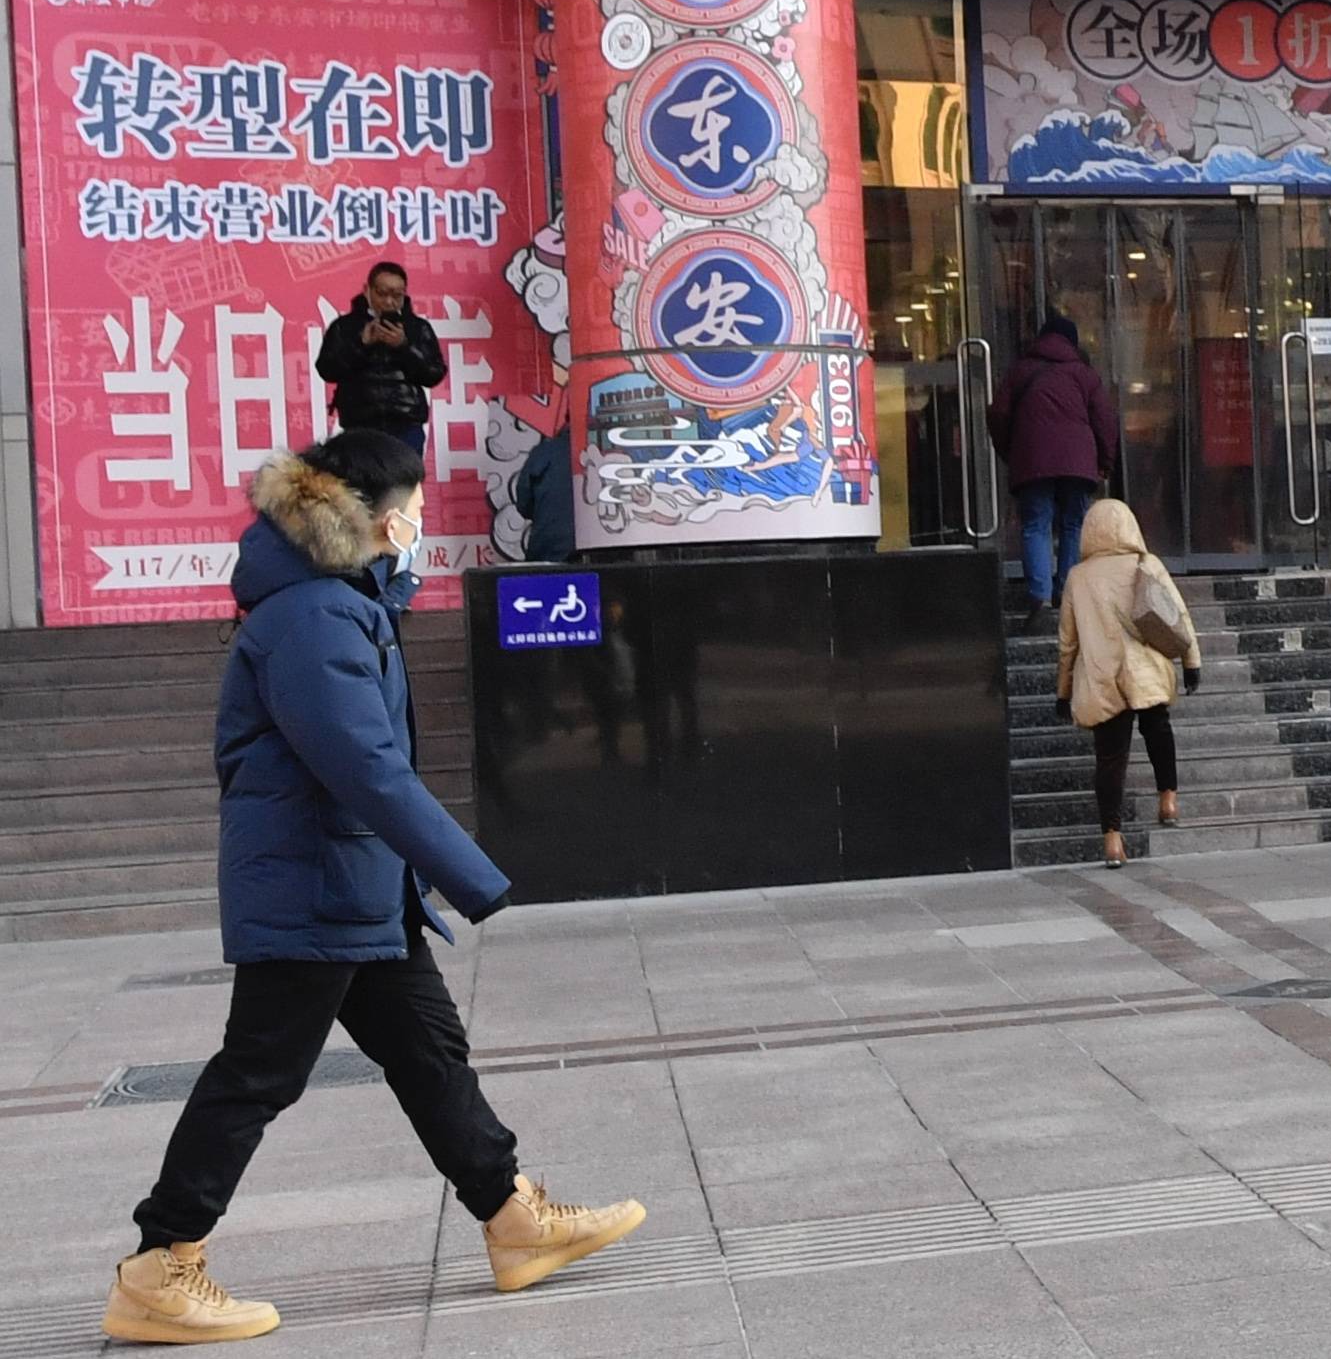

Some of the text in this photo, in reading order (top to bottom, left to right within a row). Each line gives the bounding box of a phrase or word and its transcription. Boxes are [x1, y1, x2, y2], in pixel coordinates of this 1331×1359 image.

[74, 50, 494, 168] 转型在即
[79, 178, 507, 246] 结束营业倒计时
[602, 221, 651, 275] SALE
[103, 295, 493, 491] 当日店
[827, 351, 854, 449] 1903
